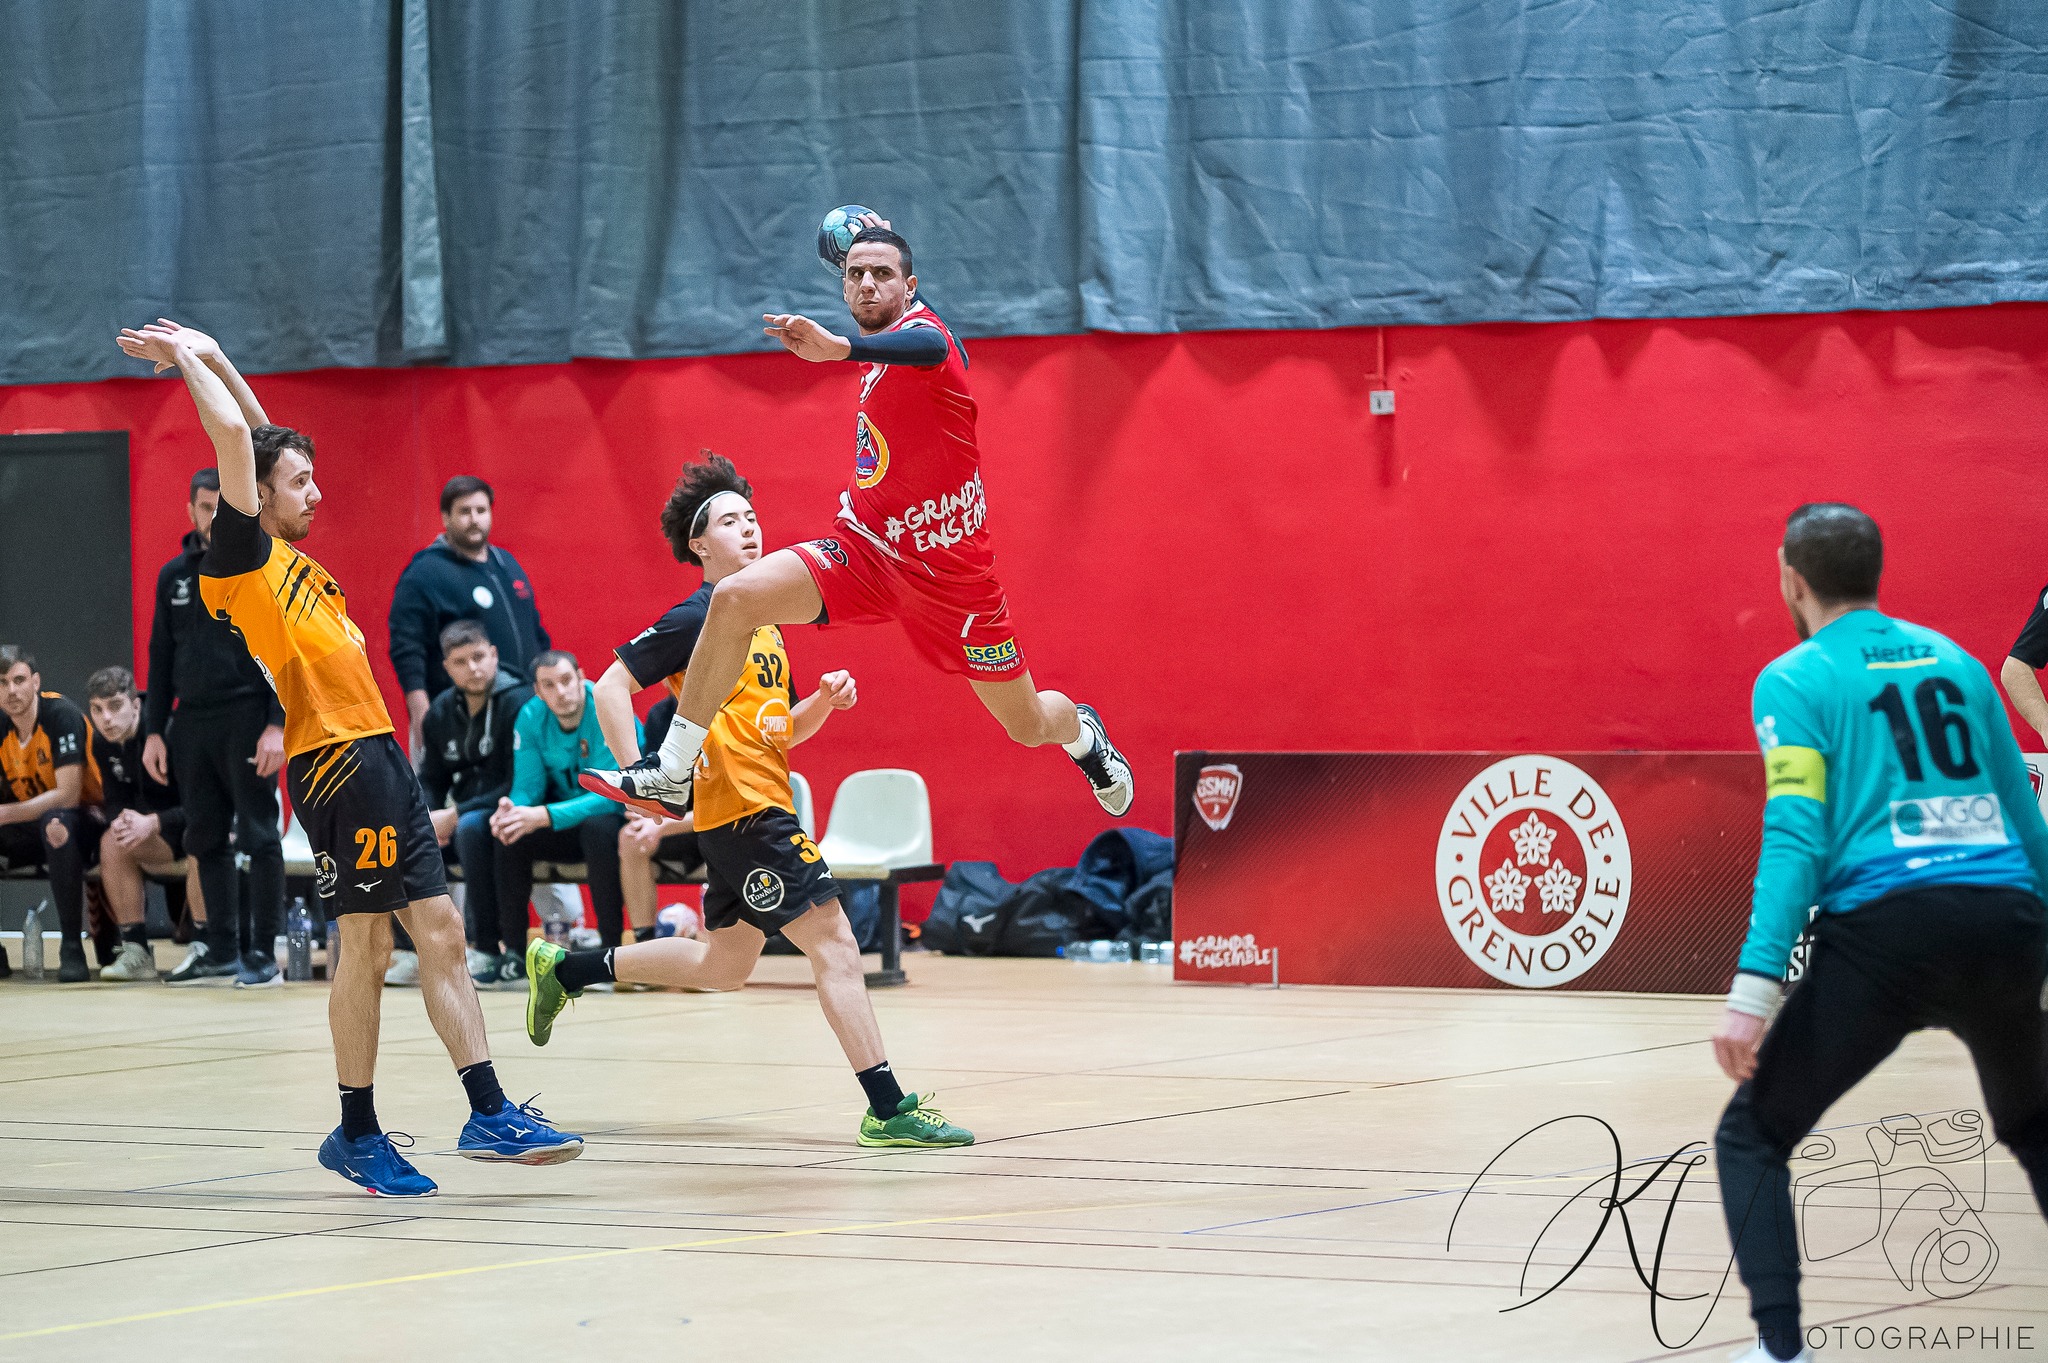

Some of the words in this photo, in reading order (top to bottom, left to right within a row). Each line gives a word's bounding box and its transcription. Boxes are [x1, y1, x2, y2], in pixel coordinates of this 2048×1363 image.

[753, 652, 784, 689] 32
[1861, 644, 1936, 664] Hertz
[1868, 676, 1981, 783] 16
[1450, 768, 1553, 840] VILLE
[1567, 786, 1615, 850] DE
[354, 825, 398, 870] 26
[748, 883, 781, 904] TONNEAU
[750, 882, 765, 894] LE
[1448, 874, 1622, 977] GRENOBLE
